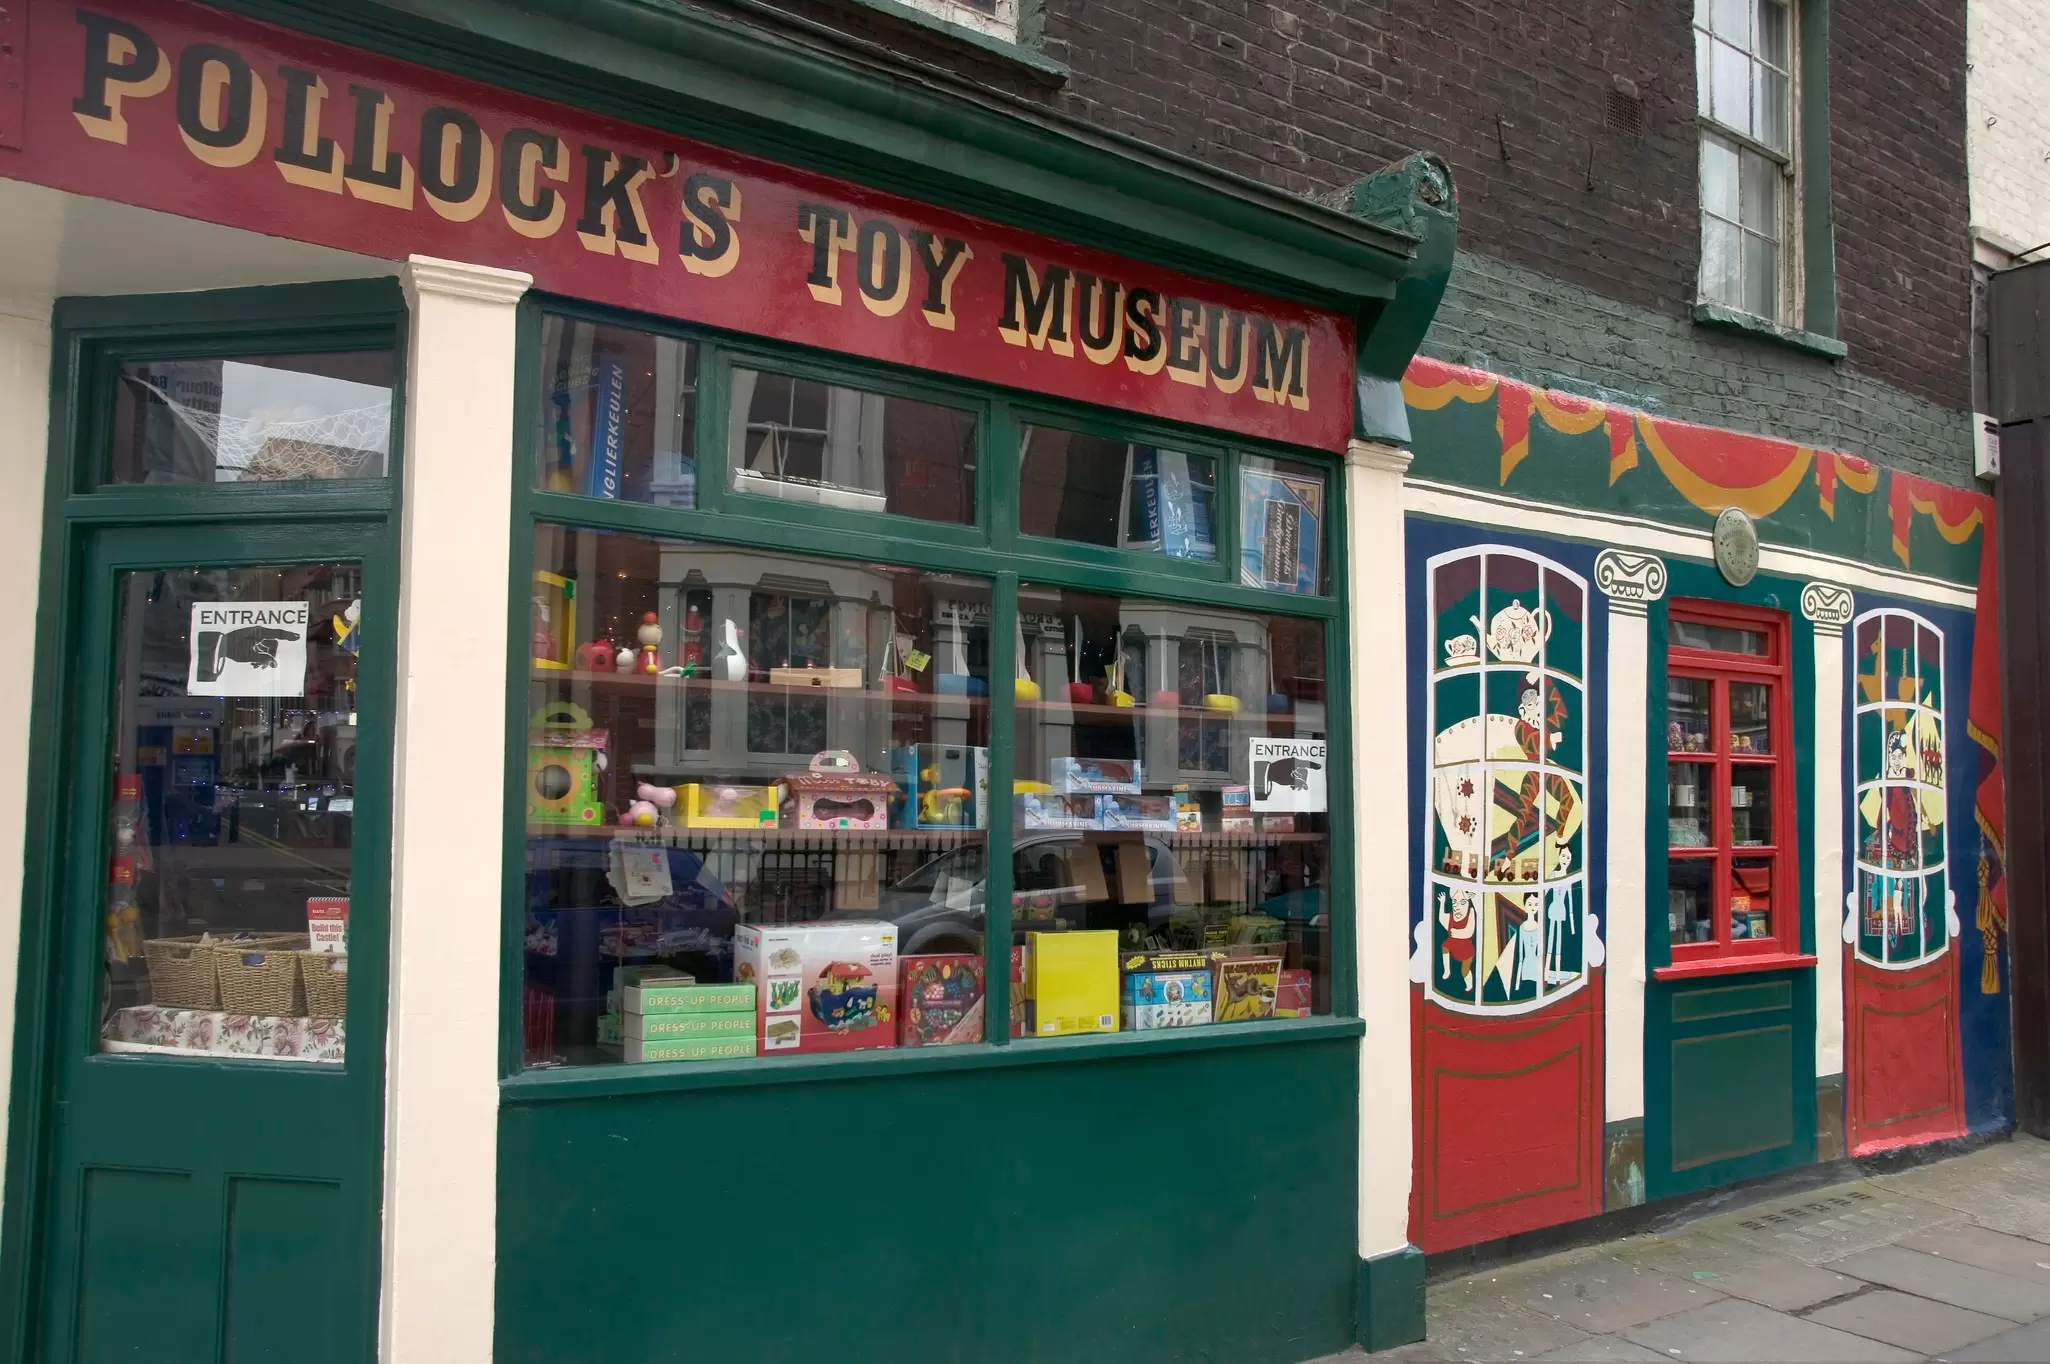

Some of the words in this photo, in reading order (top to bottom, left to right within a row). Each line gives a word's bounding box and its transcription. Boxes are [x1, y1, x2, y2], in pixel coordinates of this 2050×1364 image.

[72, 9, 743, 278] POLLOCK'S
[798, 203, 974, 331] TOY
[999, 251, 1310, 410] MUSEUM
[200, 609, 307, 625] ENTRANCE
[1255, 744, 1326, 757] ENTRANCE
[1152, 960, 1177, 969] STICKS
[1178, 958, 1206, 968] RHYTHM
[648, 996, 705, 1006] DRESS-UP
[710, 994, 751, 1004] PEOPLE
[650, 1021, 706, 1033] DRESS-UP
[711, 1019, 752, 1030] PEOPLE
[650, 1047, 706, 1060] DRESS-UP
[711, 1044, 752, 1056] PEOPLE
